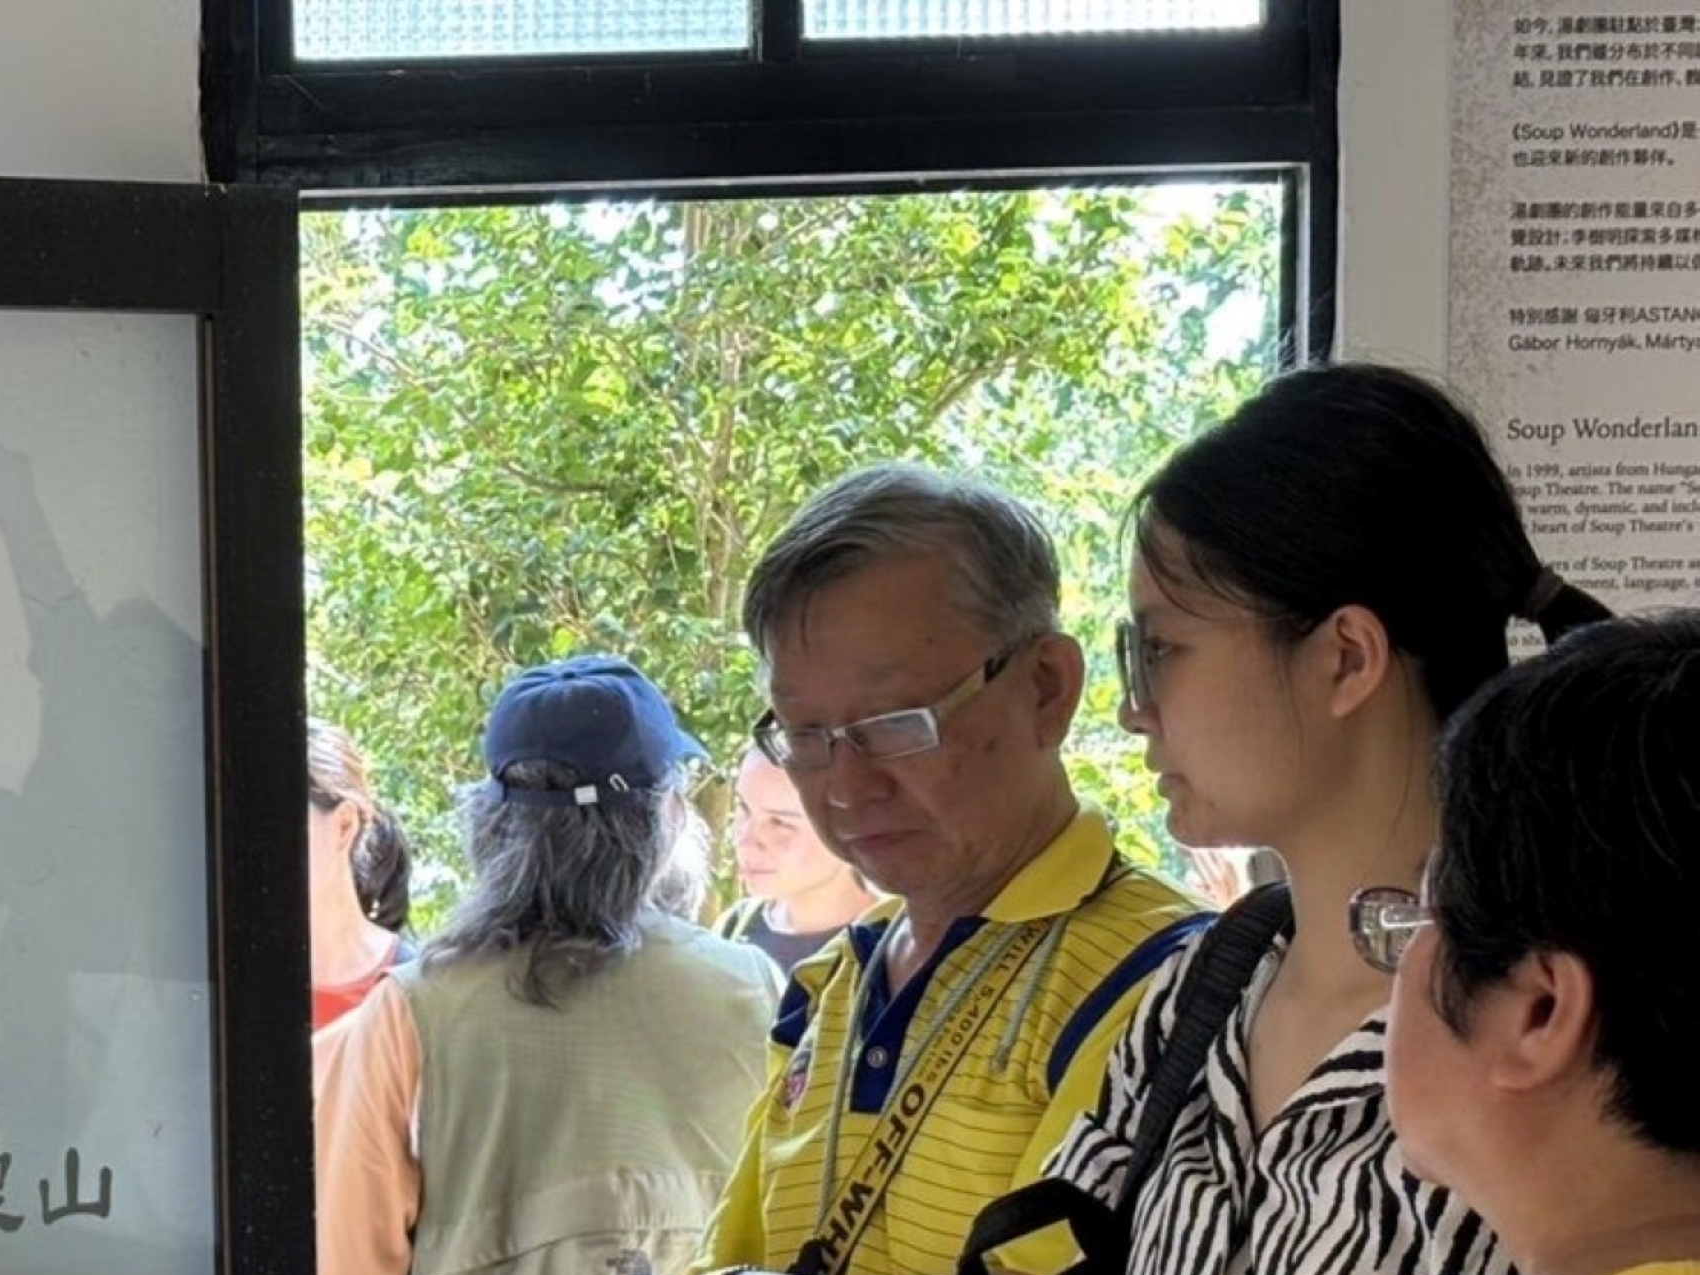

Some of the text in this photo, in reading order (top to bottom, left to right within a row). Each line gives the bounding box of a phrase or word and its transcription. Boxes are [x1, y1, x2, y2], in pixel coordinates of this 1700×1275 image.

[1508, 418, 1565, 446] Soup
[1526, 463, 1564, 479] 1999,
[1616, 462, 1649, 477] from
[1608, 482, 1633, 496] The
[1637, 484, 1675, 496] name
[1642, 499, 1668, 513] and
[1531, 519, 1567, 534] heart
[1571, 518, 1588, 534] of
[1590, 519, 1627, 536] Soup
[1572, 556, 1588, 571] of
[1591, 556, 1628, 574] Soup
[1630, 555, 1682, 571] Theatre
